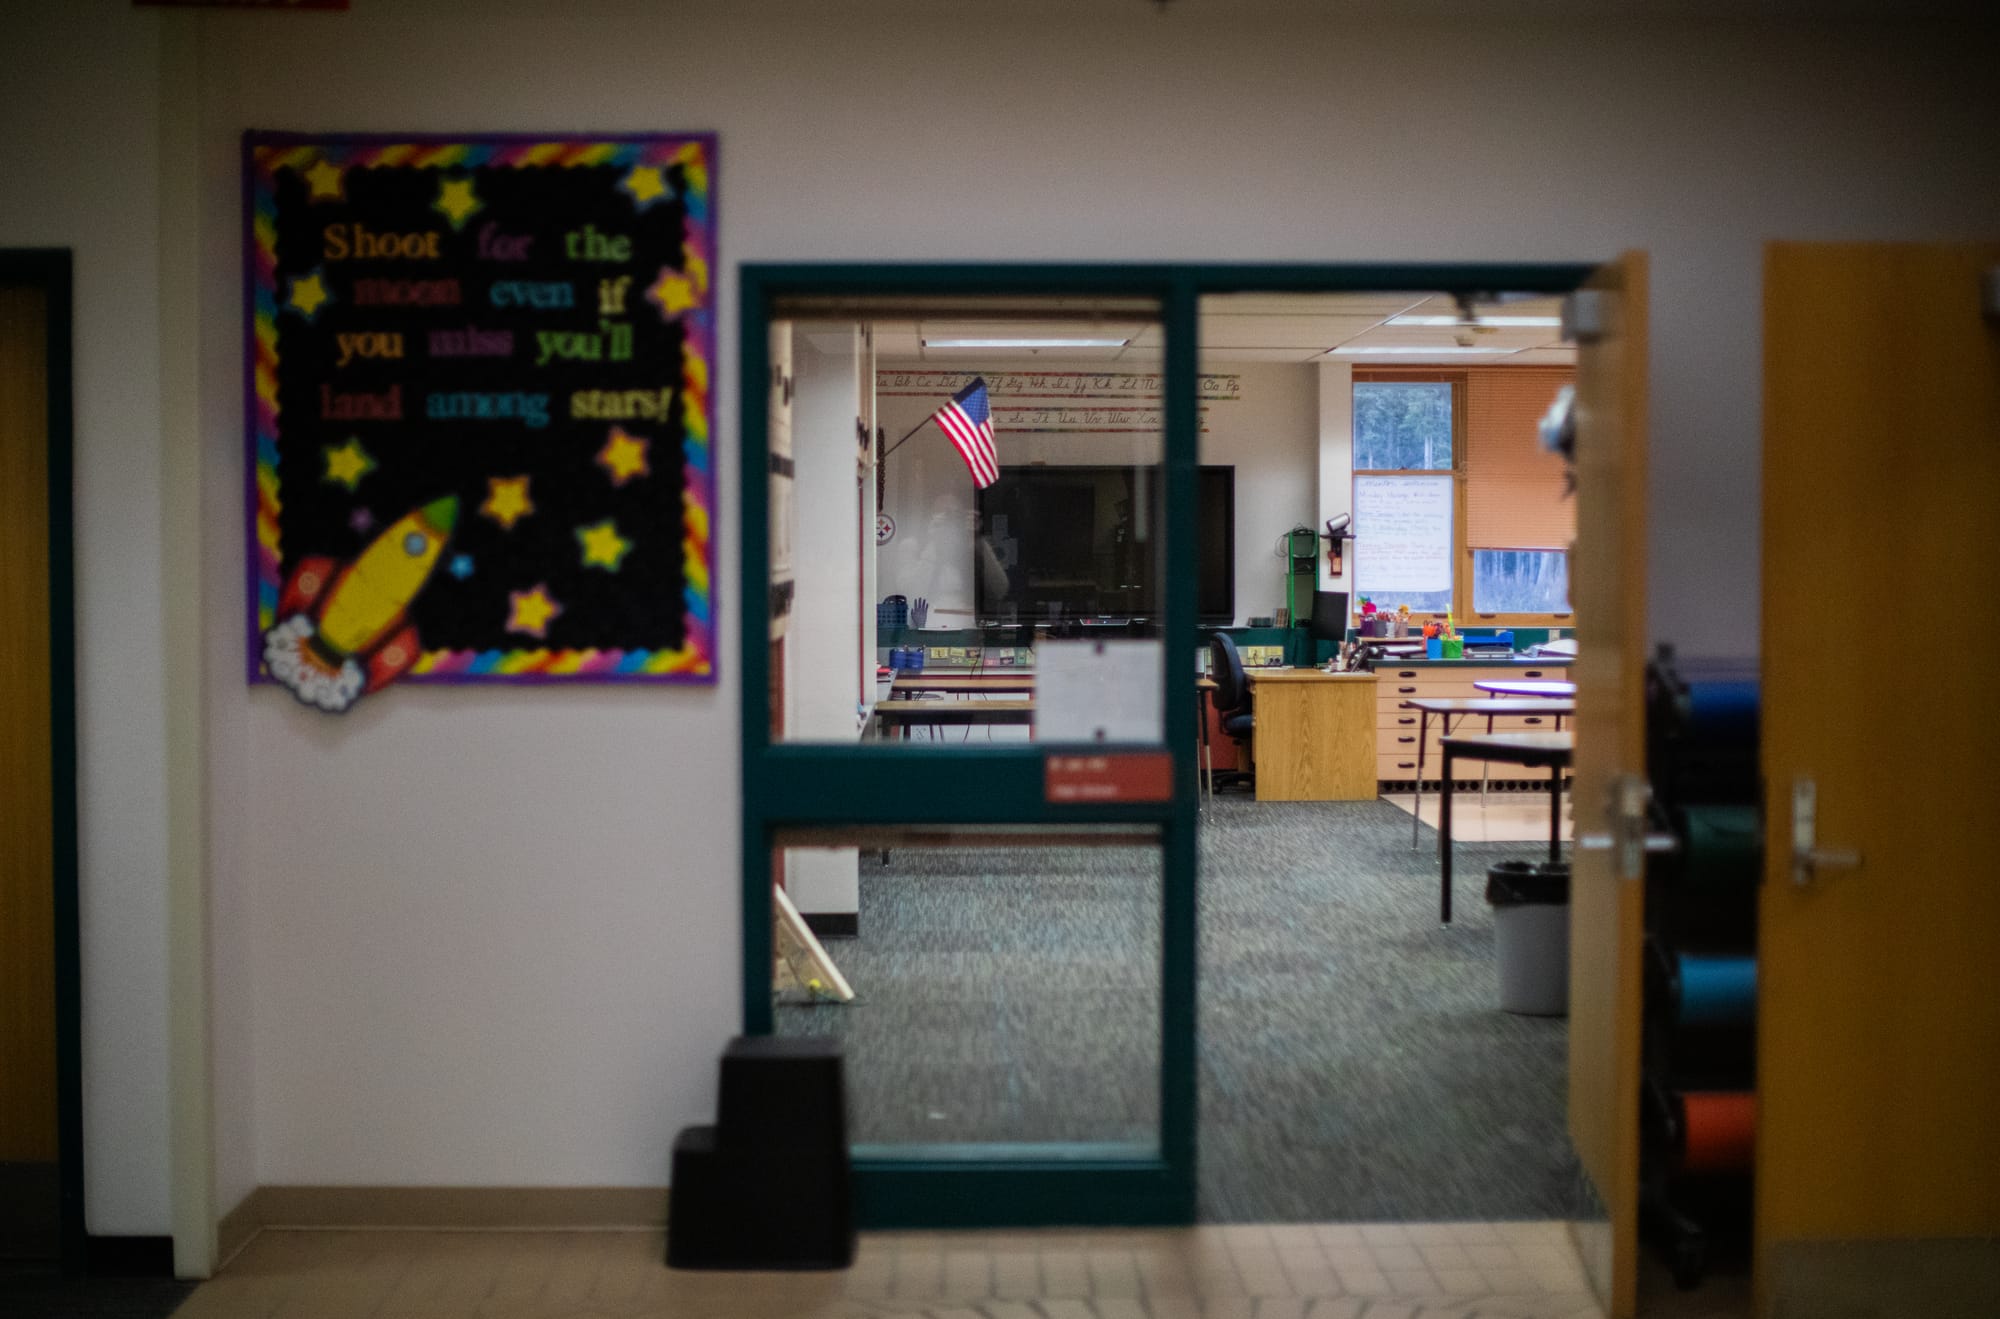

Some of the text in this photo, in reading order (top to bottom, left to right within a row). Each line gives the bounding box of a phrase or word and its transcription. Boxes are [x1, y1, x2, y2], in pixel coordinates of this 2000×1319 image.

[322, 220, 634, 264] Shoot for the
[351, 274, 634, 316] moon even if
[335, 318, 635, 368] you miss you'll
[318, 382, 673, 429] land among stars!
